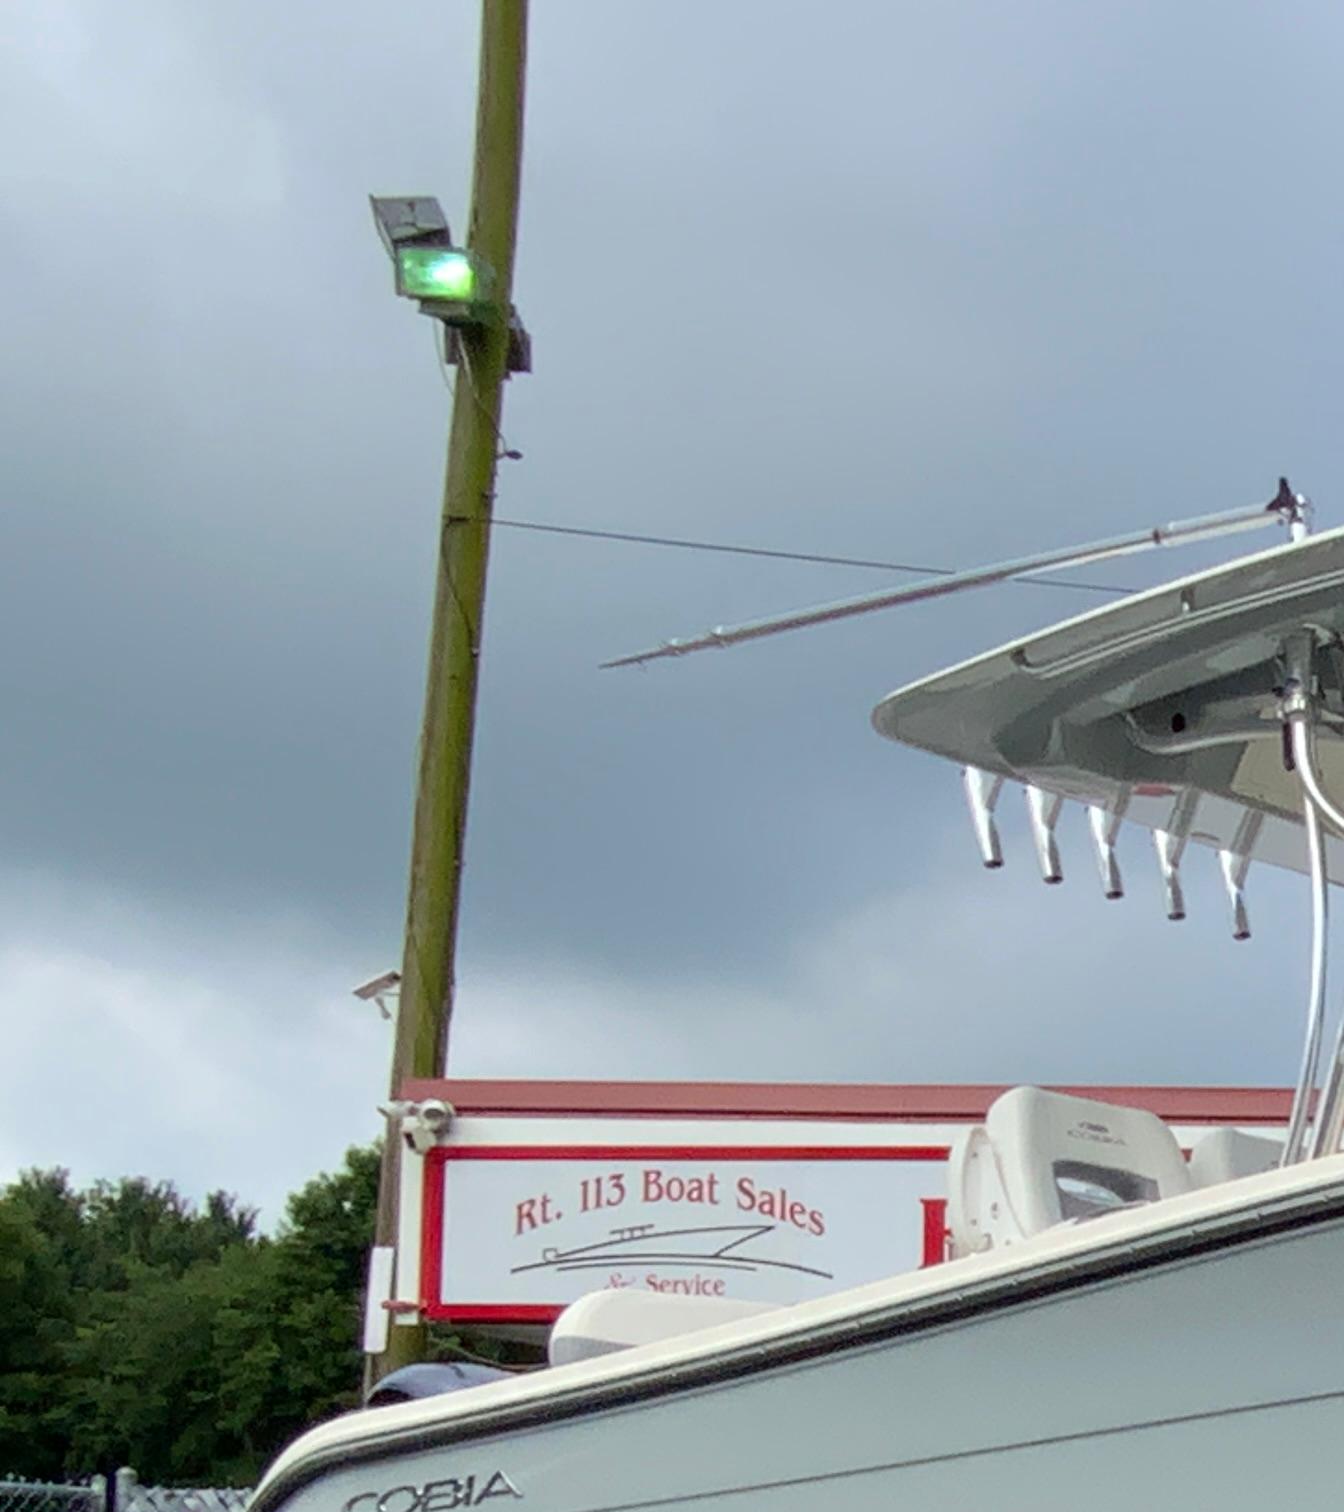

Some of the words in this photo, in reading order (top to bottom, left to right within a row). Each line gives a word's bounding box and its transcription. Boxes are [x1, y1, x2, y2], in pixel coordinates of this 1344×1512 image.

[514, 1195, 563, 1237] Rt.
[580, 1173, 626, 1212] 113
[642, 1169, 720, 1205] Boat
[736, 1177, 825, 1237] Sales
[644, 1272, 726, 1296] Service
